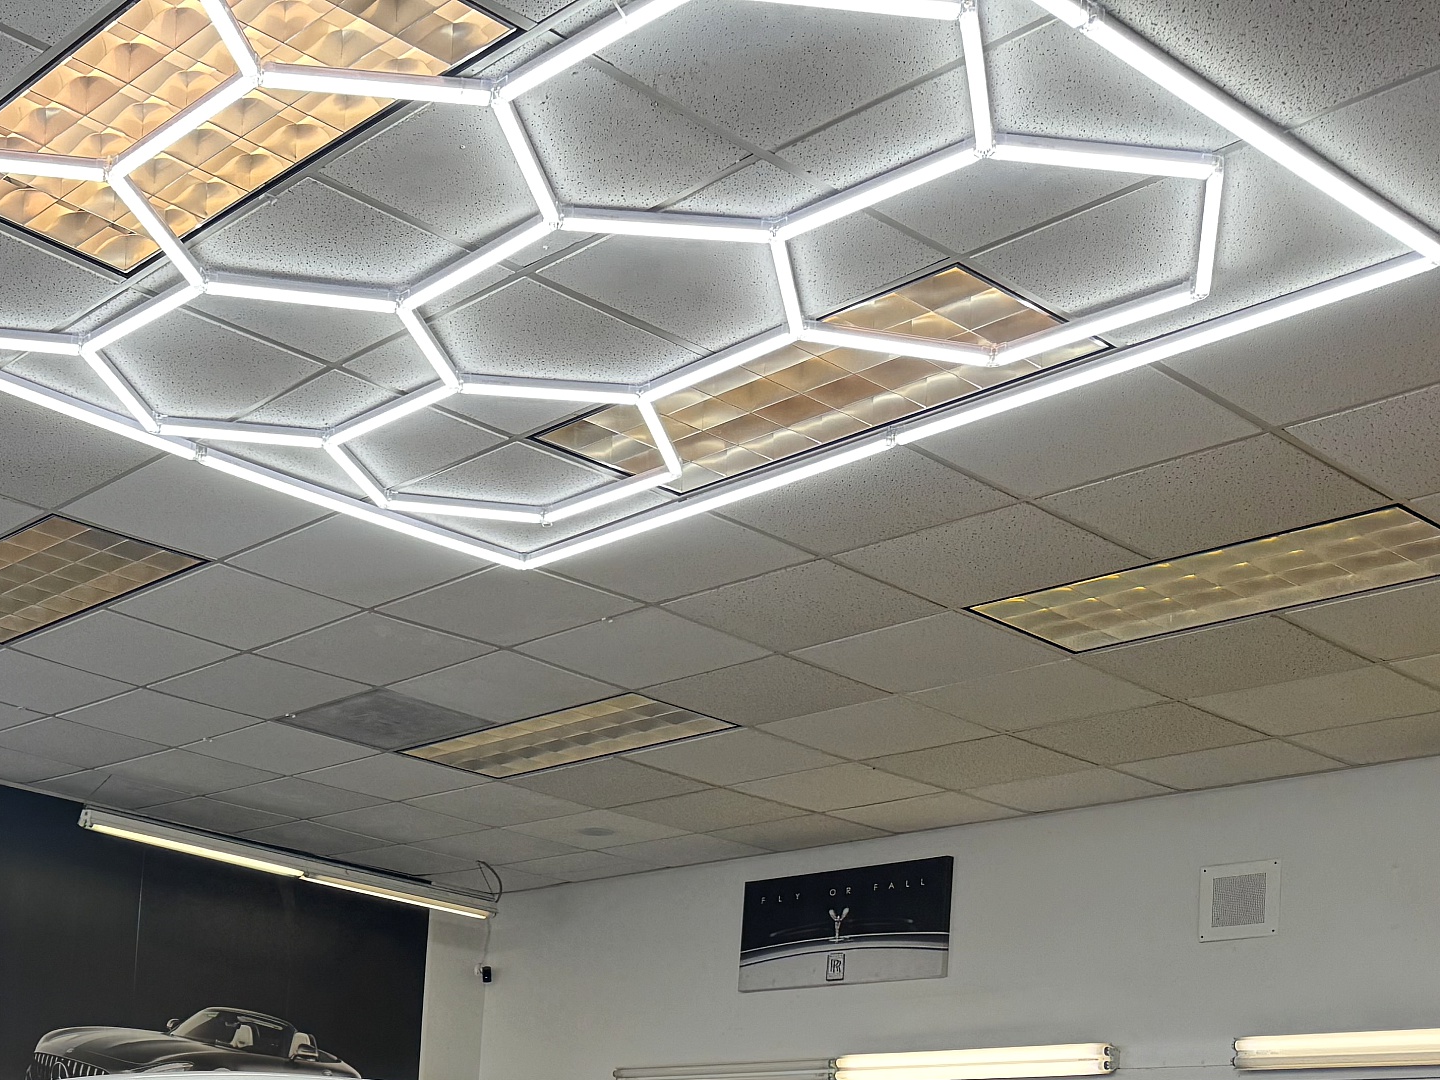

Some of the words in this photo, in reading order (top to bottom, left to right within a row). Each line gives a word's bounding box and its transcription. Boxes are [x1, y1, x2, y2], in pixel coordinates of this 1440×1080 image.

[761, 892, 800, 904] FLY
[829, 886, 852, 897] OR
[873, 878, 925, 891] FALL
